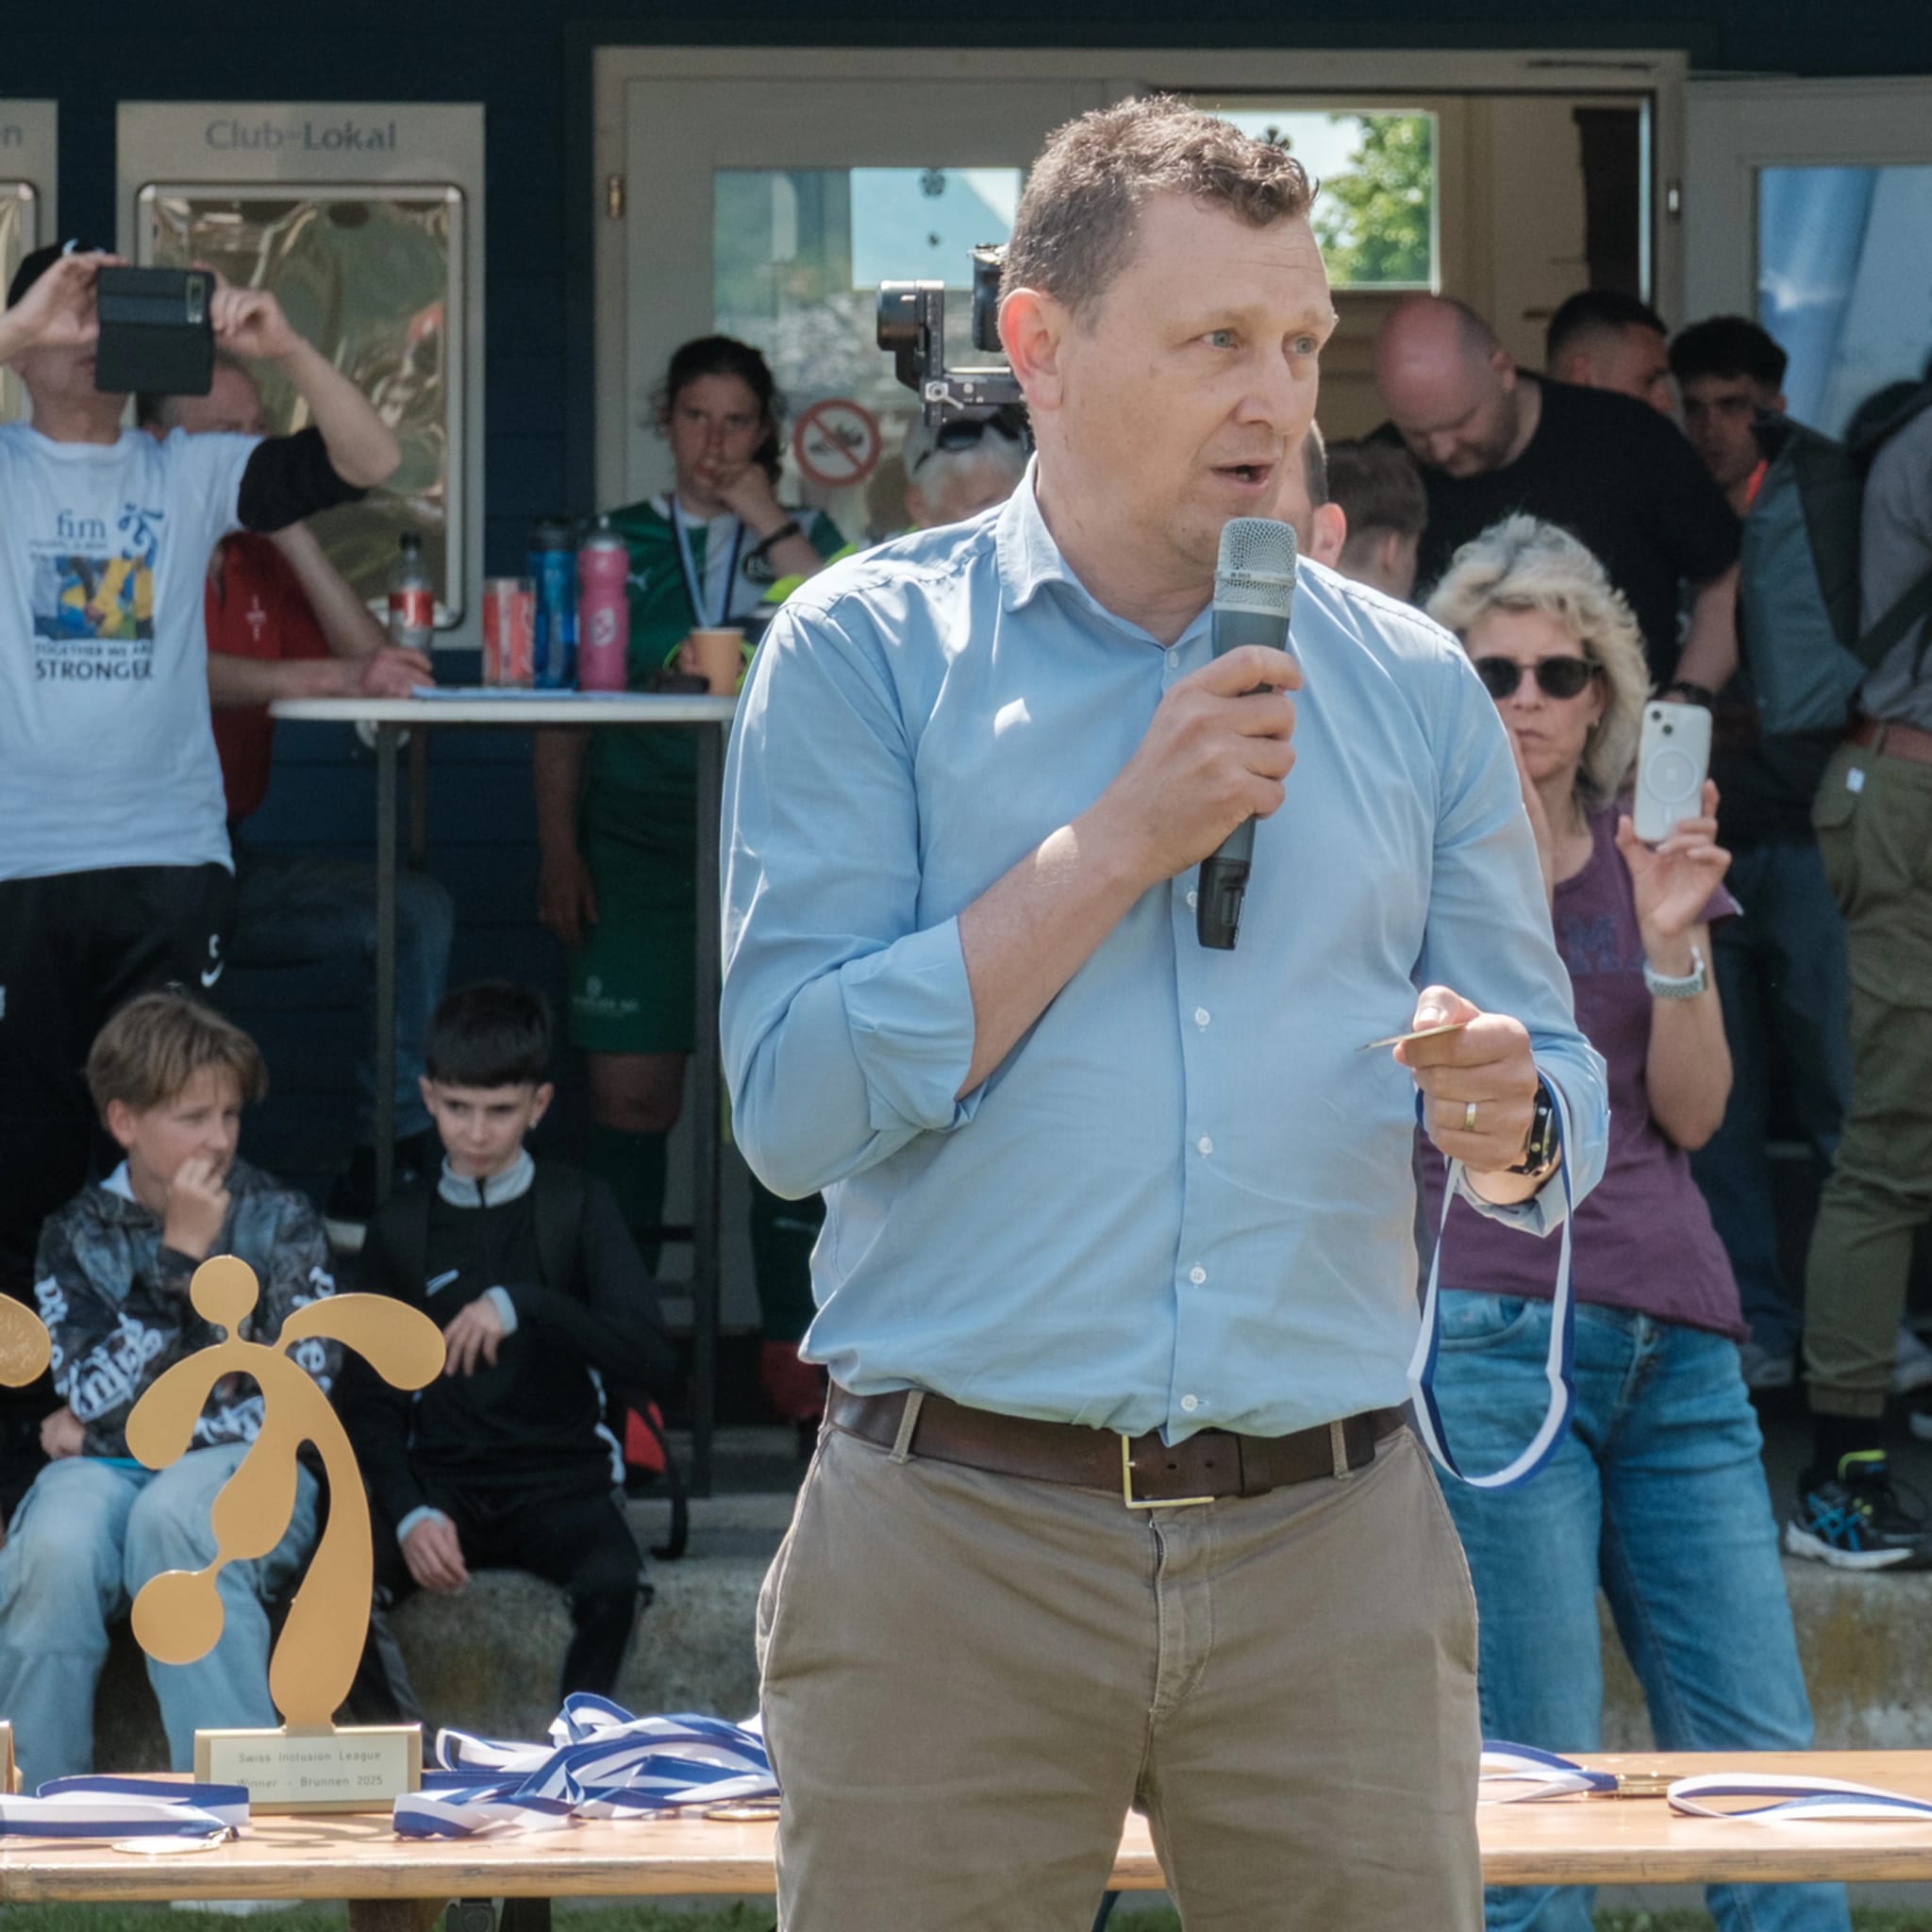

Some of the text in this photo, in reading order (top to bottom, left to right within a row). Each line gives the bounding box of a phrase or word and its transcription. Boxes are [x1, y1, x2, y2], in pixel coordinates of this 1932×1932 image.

[205, 119, 397, 151] Club-Lokal
[238, 1750, 382, 1764] Swiss Inclusion League
[300, 1775, 350, 1788] Brunnen
[357, 1774, 383, 1786] 2025
